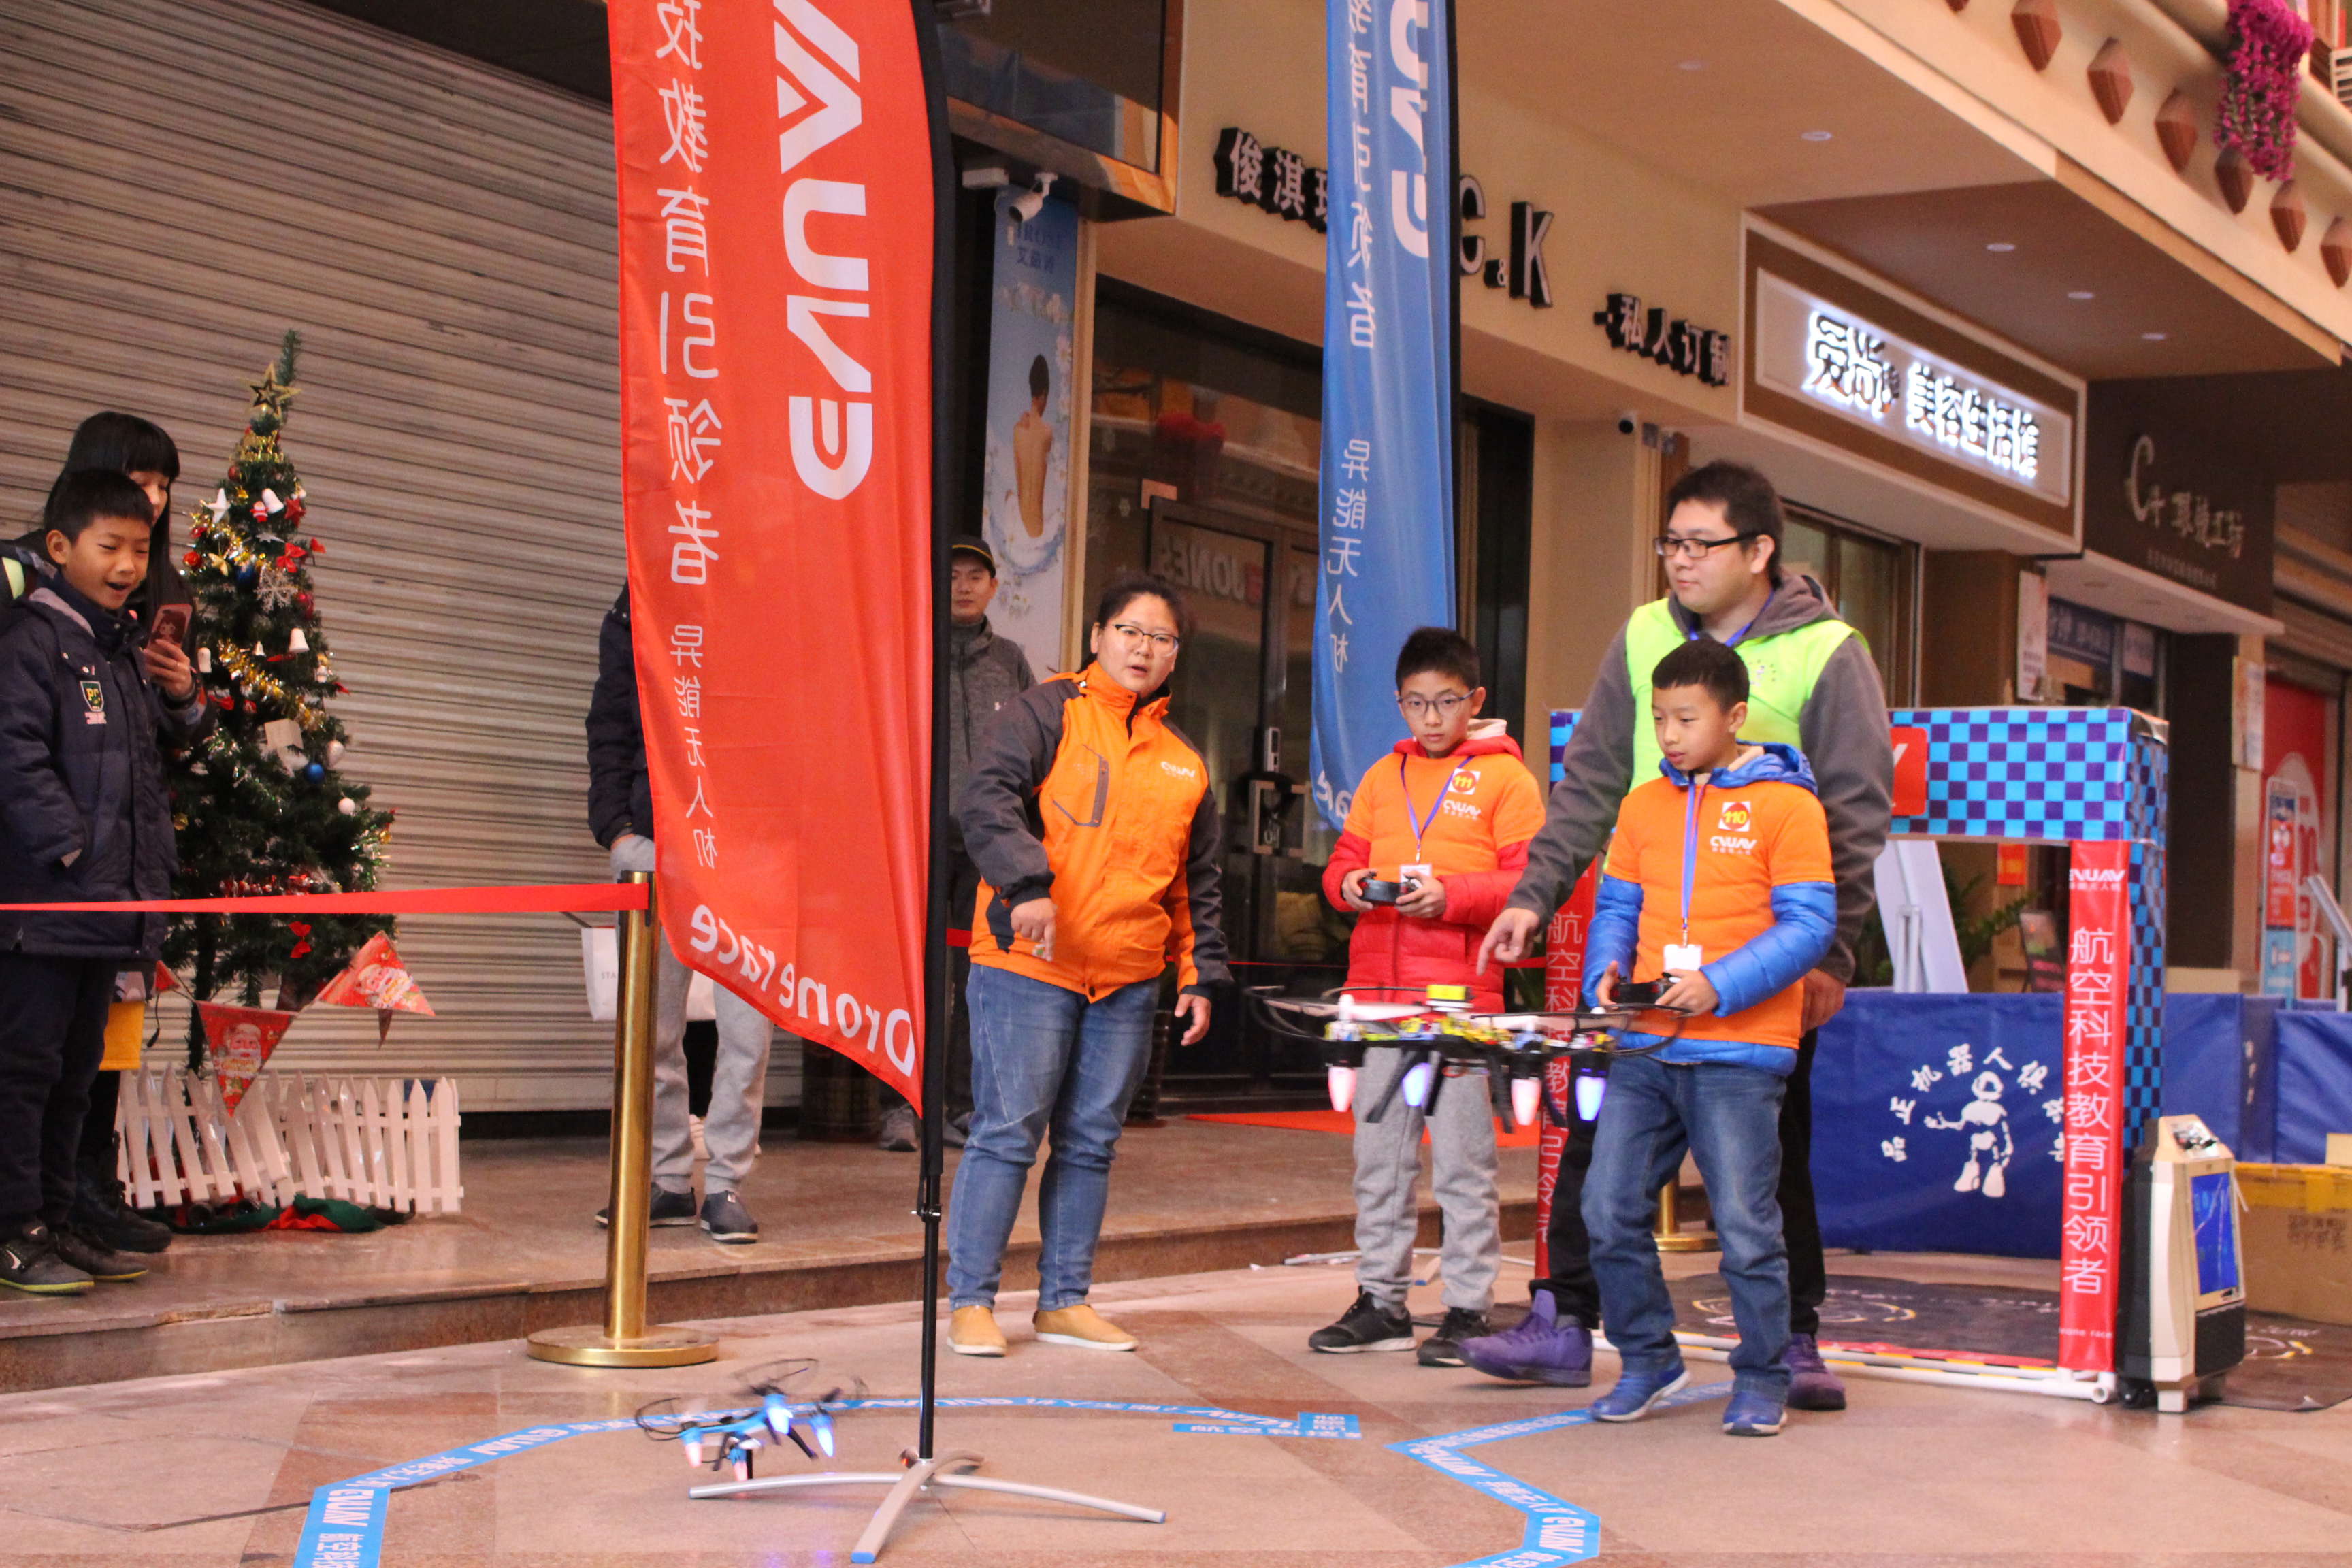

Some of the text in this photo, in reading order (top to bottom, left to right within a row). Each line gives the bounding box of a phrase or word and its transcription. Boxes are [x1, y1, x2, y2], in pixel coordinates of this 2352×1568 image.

[1723, 811, 1748, 824] 110
[2062, 927, 2114, 1294] 航空科技教育引领者
